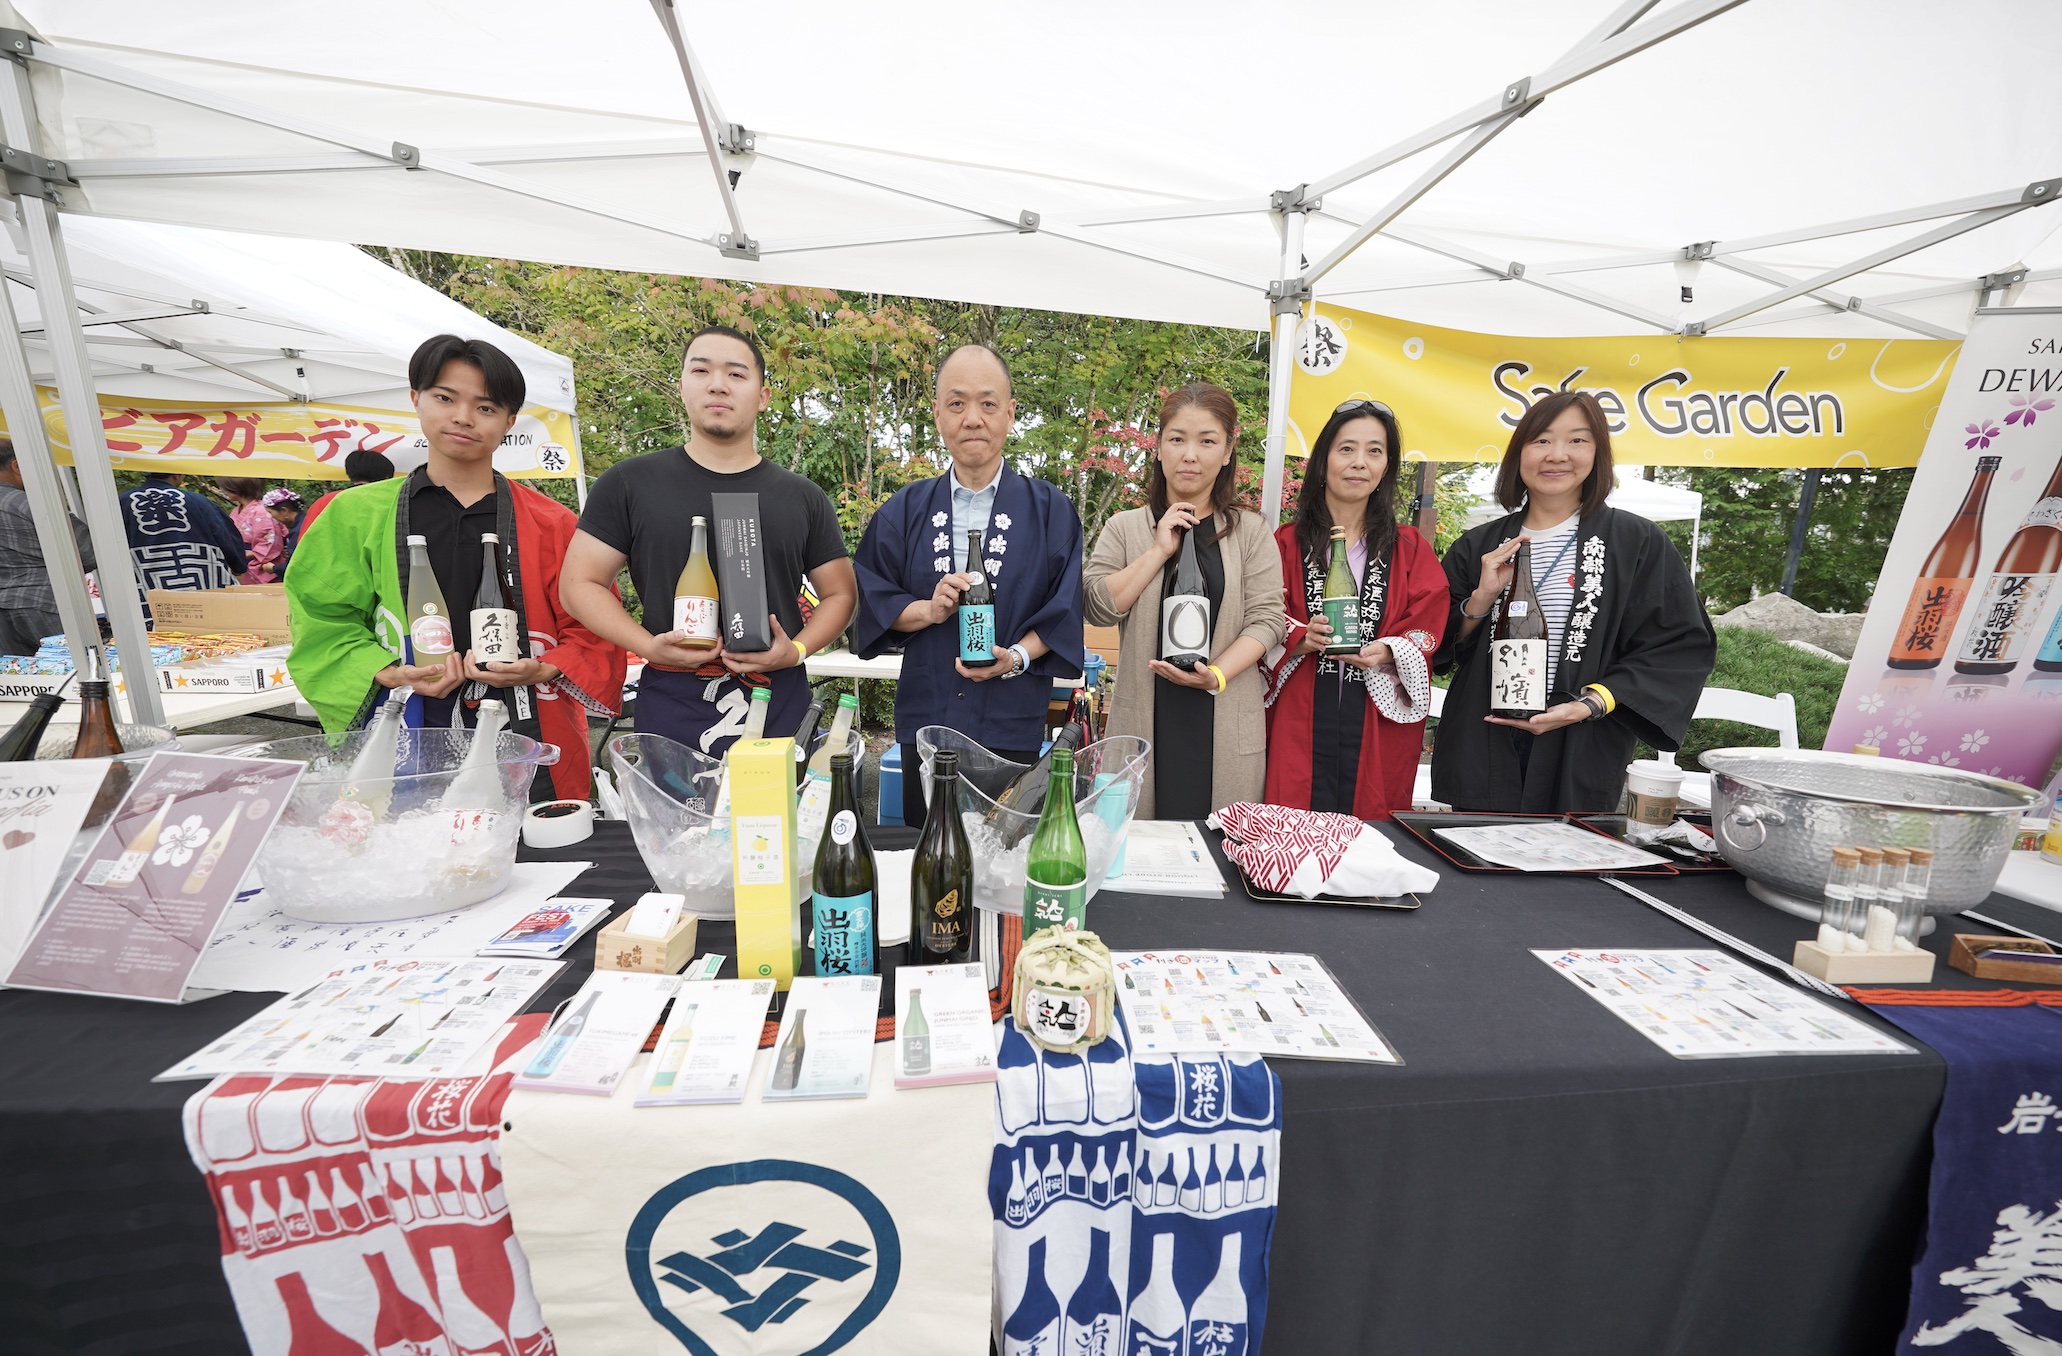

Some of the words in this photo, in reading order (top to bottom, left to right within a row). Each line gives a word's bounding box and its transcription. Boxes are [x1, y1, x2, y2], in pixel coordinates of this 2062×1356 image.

[1640, 366, 1843, 435] Garden
[1979, 368, 2062, 392] DEW
[932, 531, 951, 574] 出羽
[479, 612, 502, 654] 久保田
[684, 599, 698, 635] りんご
[965, 611, 986, 652] 出羽桜
[1905, 586, 1953, 652] 出羽桜
[191, 677, 229, 687] SAPPORO
[27, 785, 60, 799] ON
[526, 912, 570, 922] FEST
[538, 904, 596, 914] SAKE
[931, 921, 961, 935] IMA
[818, 907, 853, 974] 出羽桜
[1190, 1064, 1219, 1121] 桜花
[1998, 1090, 2062, 1134] 岩
